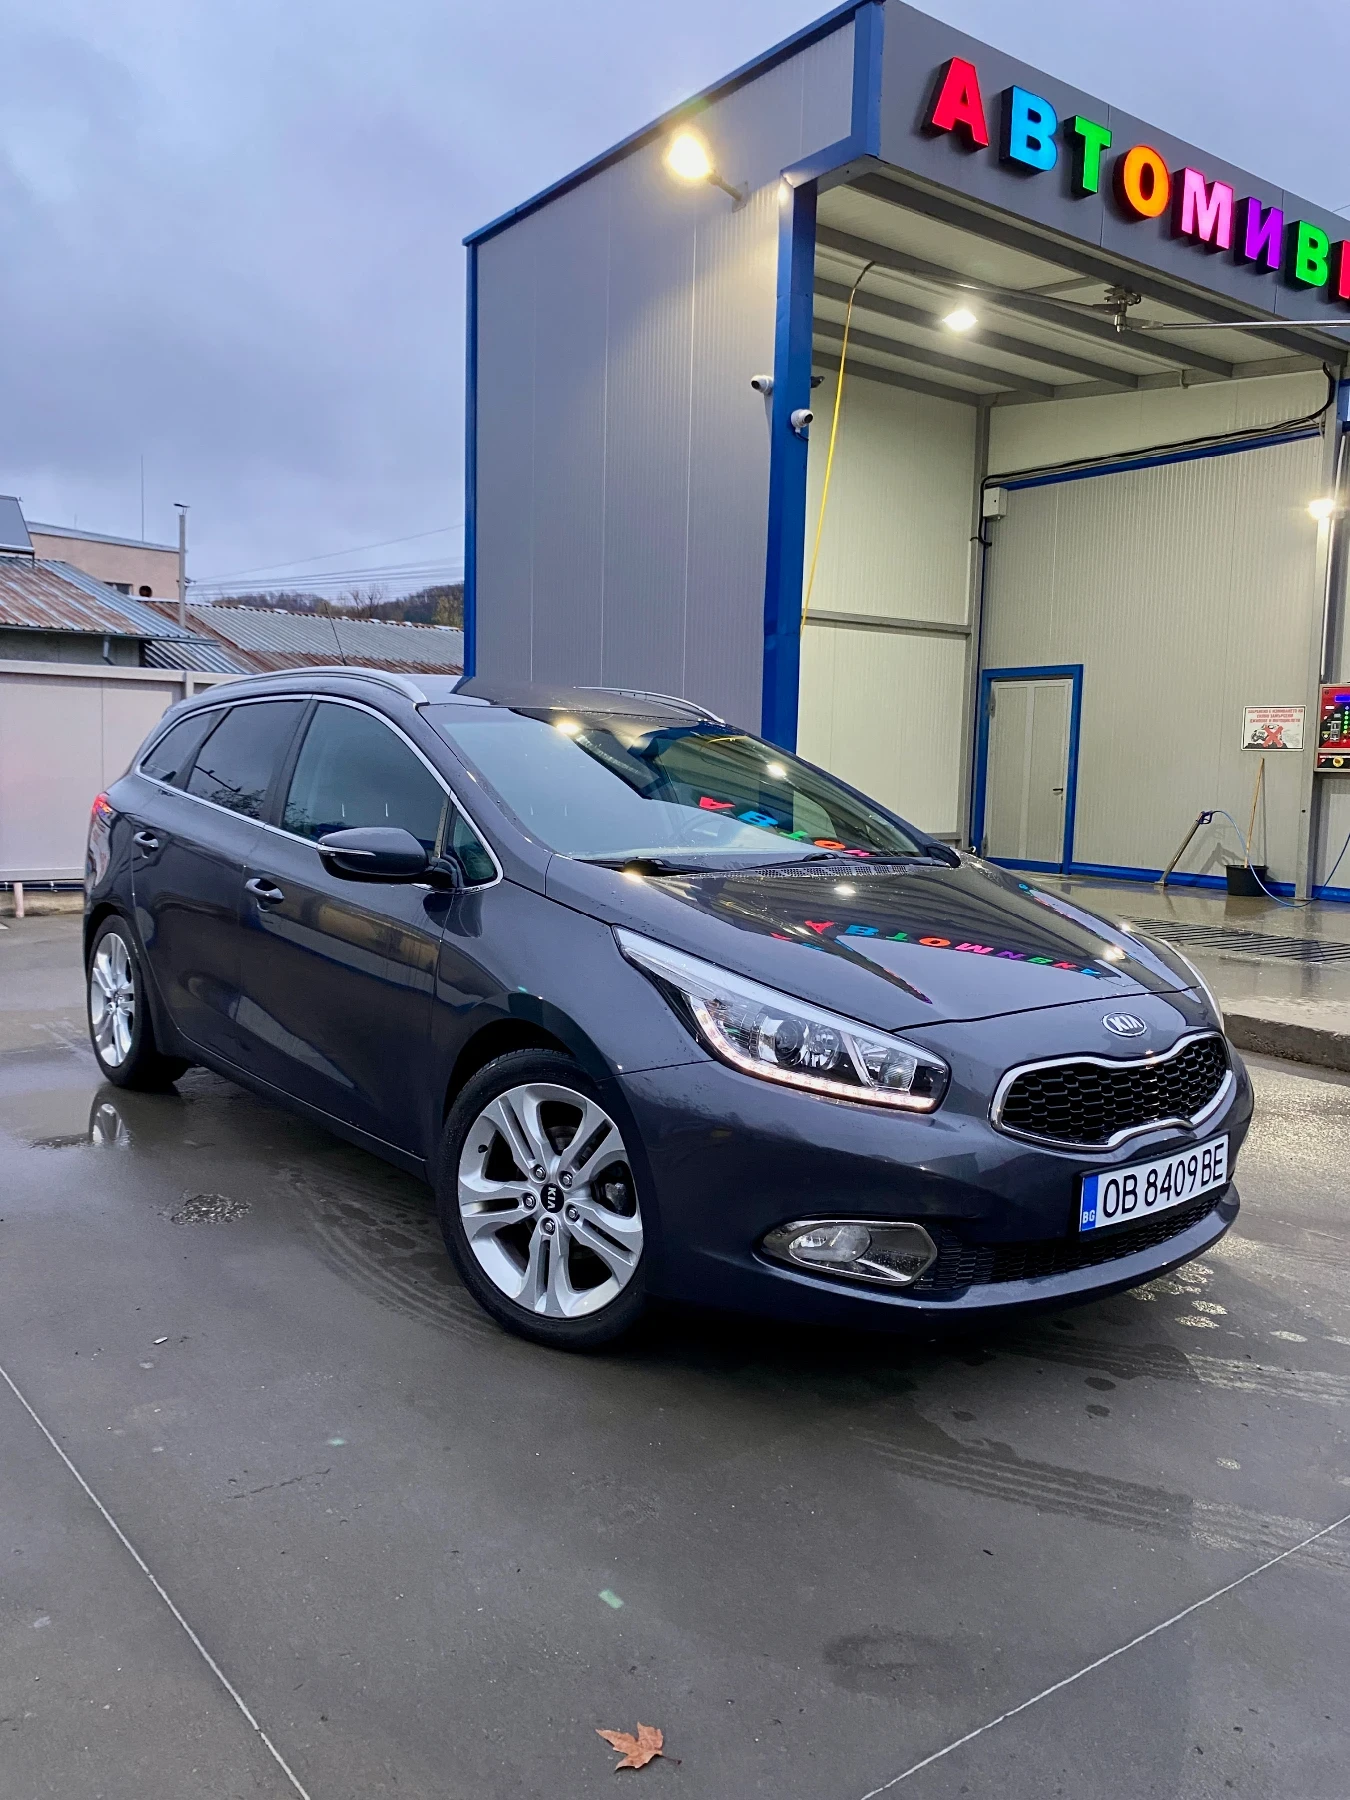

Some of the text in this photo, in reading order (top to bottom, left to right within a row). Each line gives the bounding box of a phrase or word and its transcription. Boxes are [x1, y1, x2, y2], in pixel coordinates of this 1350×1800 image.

[1107, 1016, 1144, 1032] KIA
[547, 1186, 557, 1210] KIA
[1082, 1209, 1096, 1224] BG
